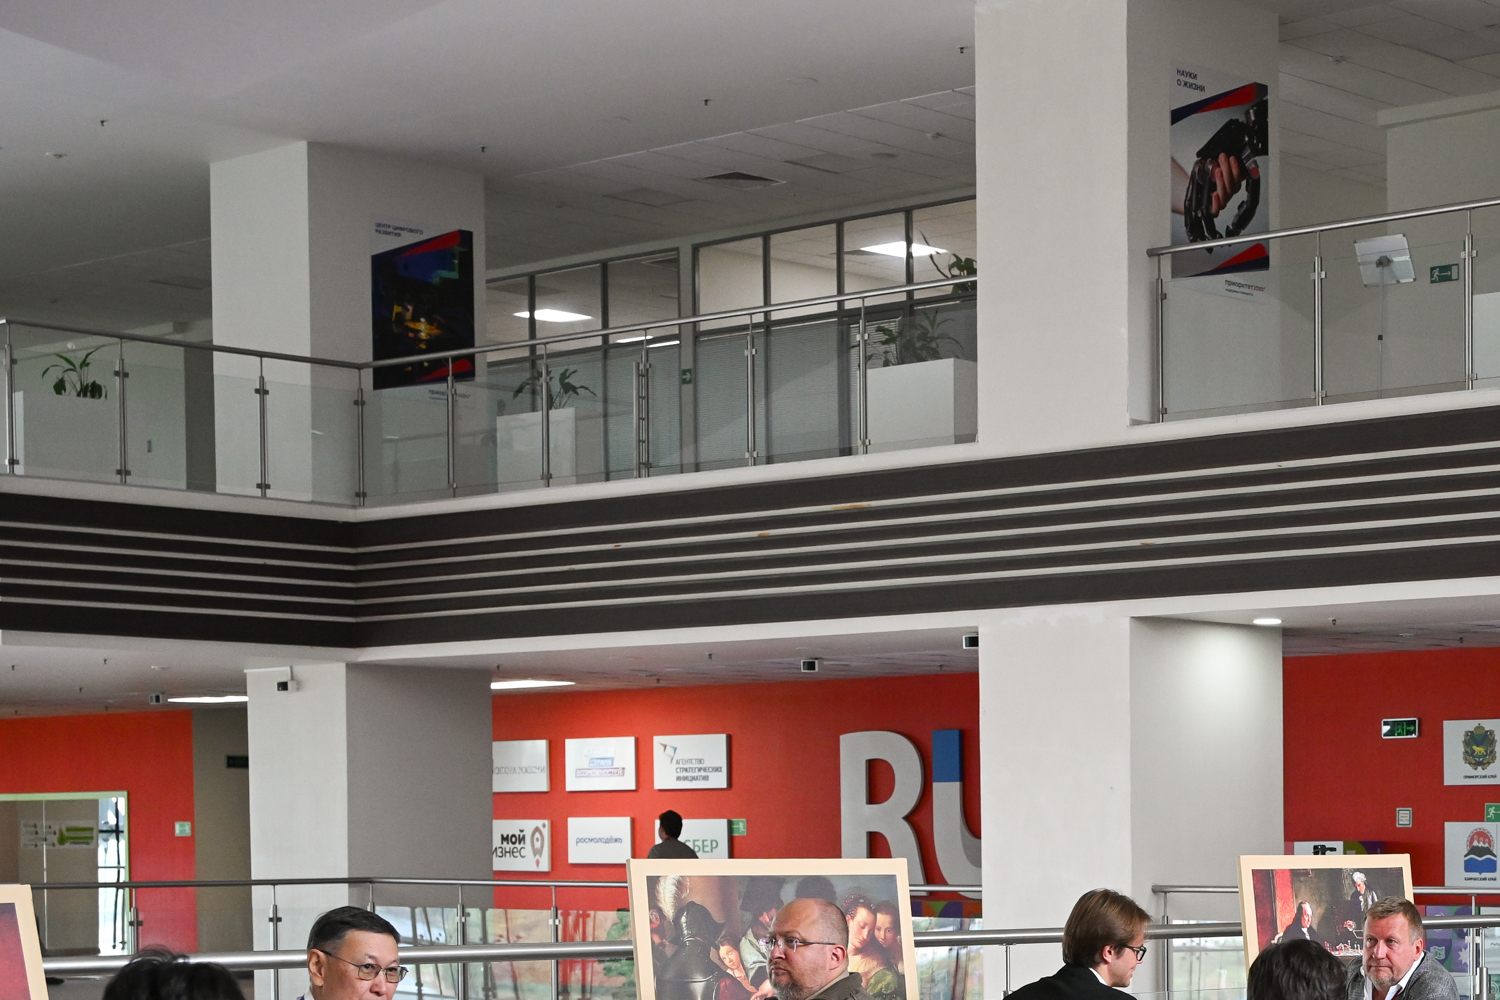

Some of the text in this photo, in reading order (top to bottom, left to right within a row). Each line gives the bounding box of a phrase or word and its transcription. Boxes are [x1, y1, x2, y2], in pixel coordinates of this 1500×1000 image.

[1176, 68, 1198, 81] НАУКИ
[1176, 78, 1206, 93] О ЖИЗНИ
[675, 758, 705, 766] АГЕНТСТВО
[675, 766, 723, 774] СТРАТЕГИЧЕСКИХ
[492, 845, 526, 859] изнес
